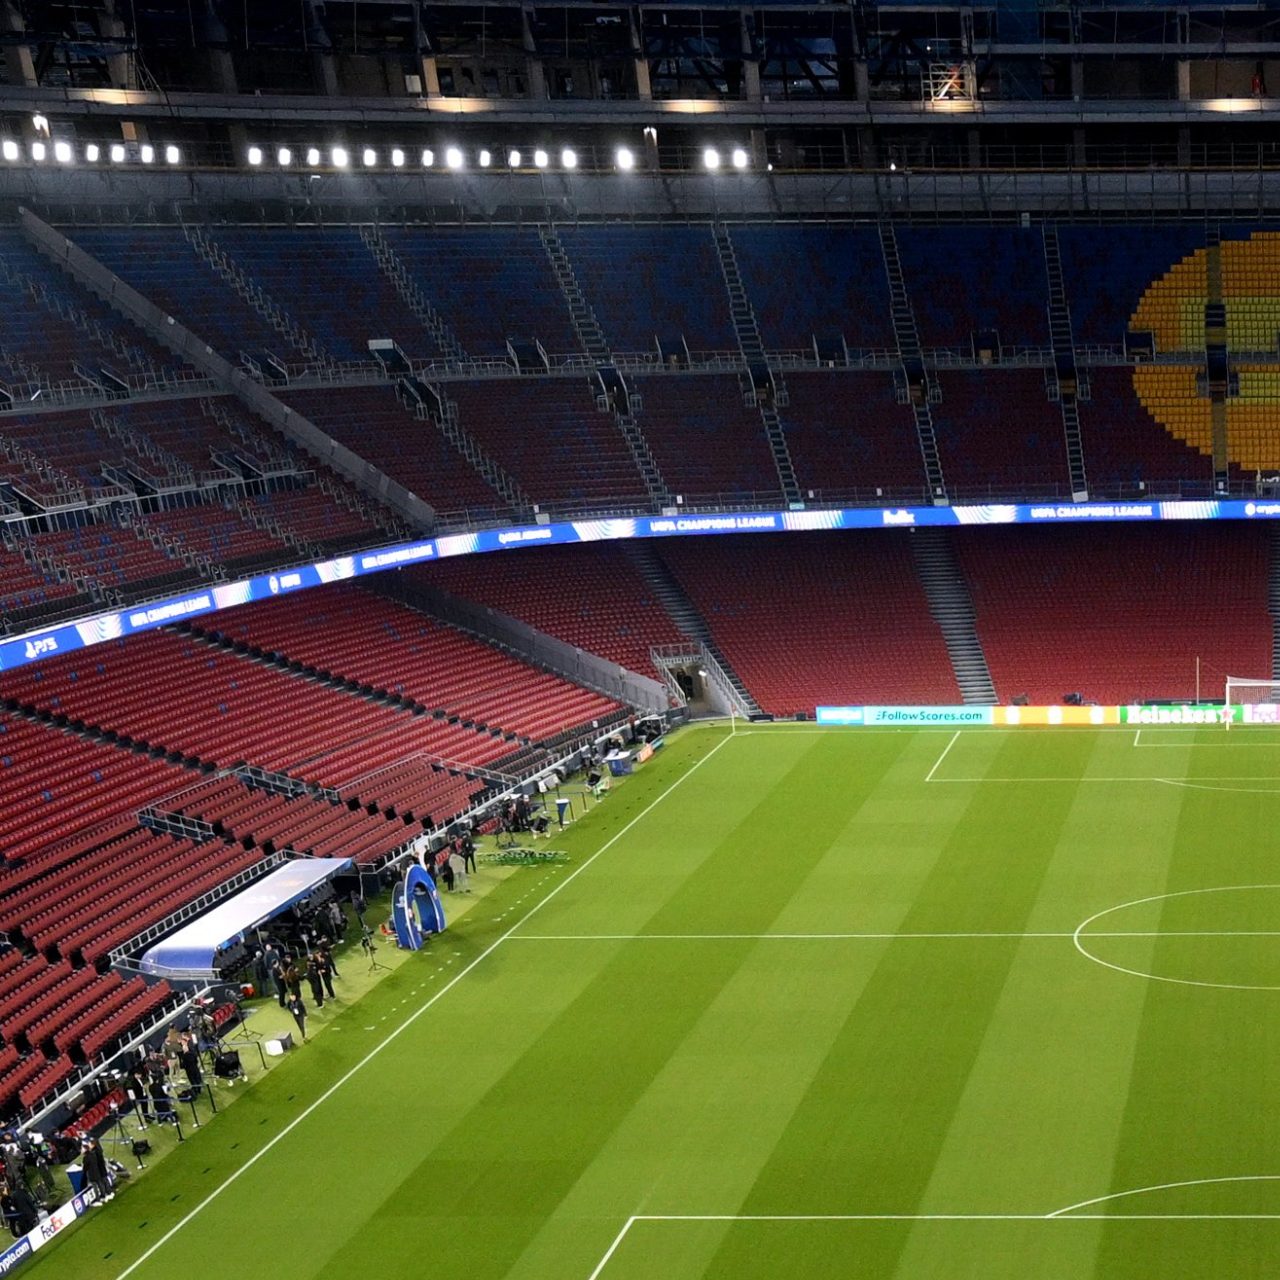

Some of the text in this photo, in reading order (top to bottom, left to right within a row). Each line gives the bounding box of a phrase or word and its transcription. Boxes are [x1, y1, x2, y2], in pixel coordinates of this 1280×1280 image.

[1031, 506, 1153, 518] UEFA CHAMPIONS LEAGUE
[650, 516, 775, 532] UEFA CHAMPIONS LEAGUE
[35, 637, 58, 654] PS5
[881, 710, 983, 721] FollowScores.com
[1127, 705, 1218, 723] Heineken
[41, 1216, 64, 1240] FedEx
